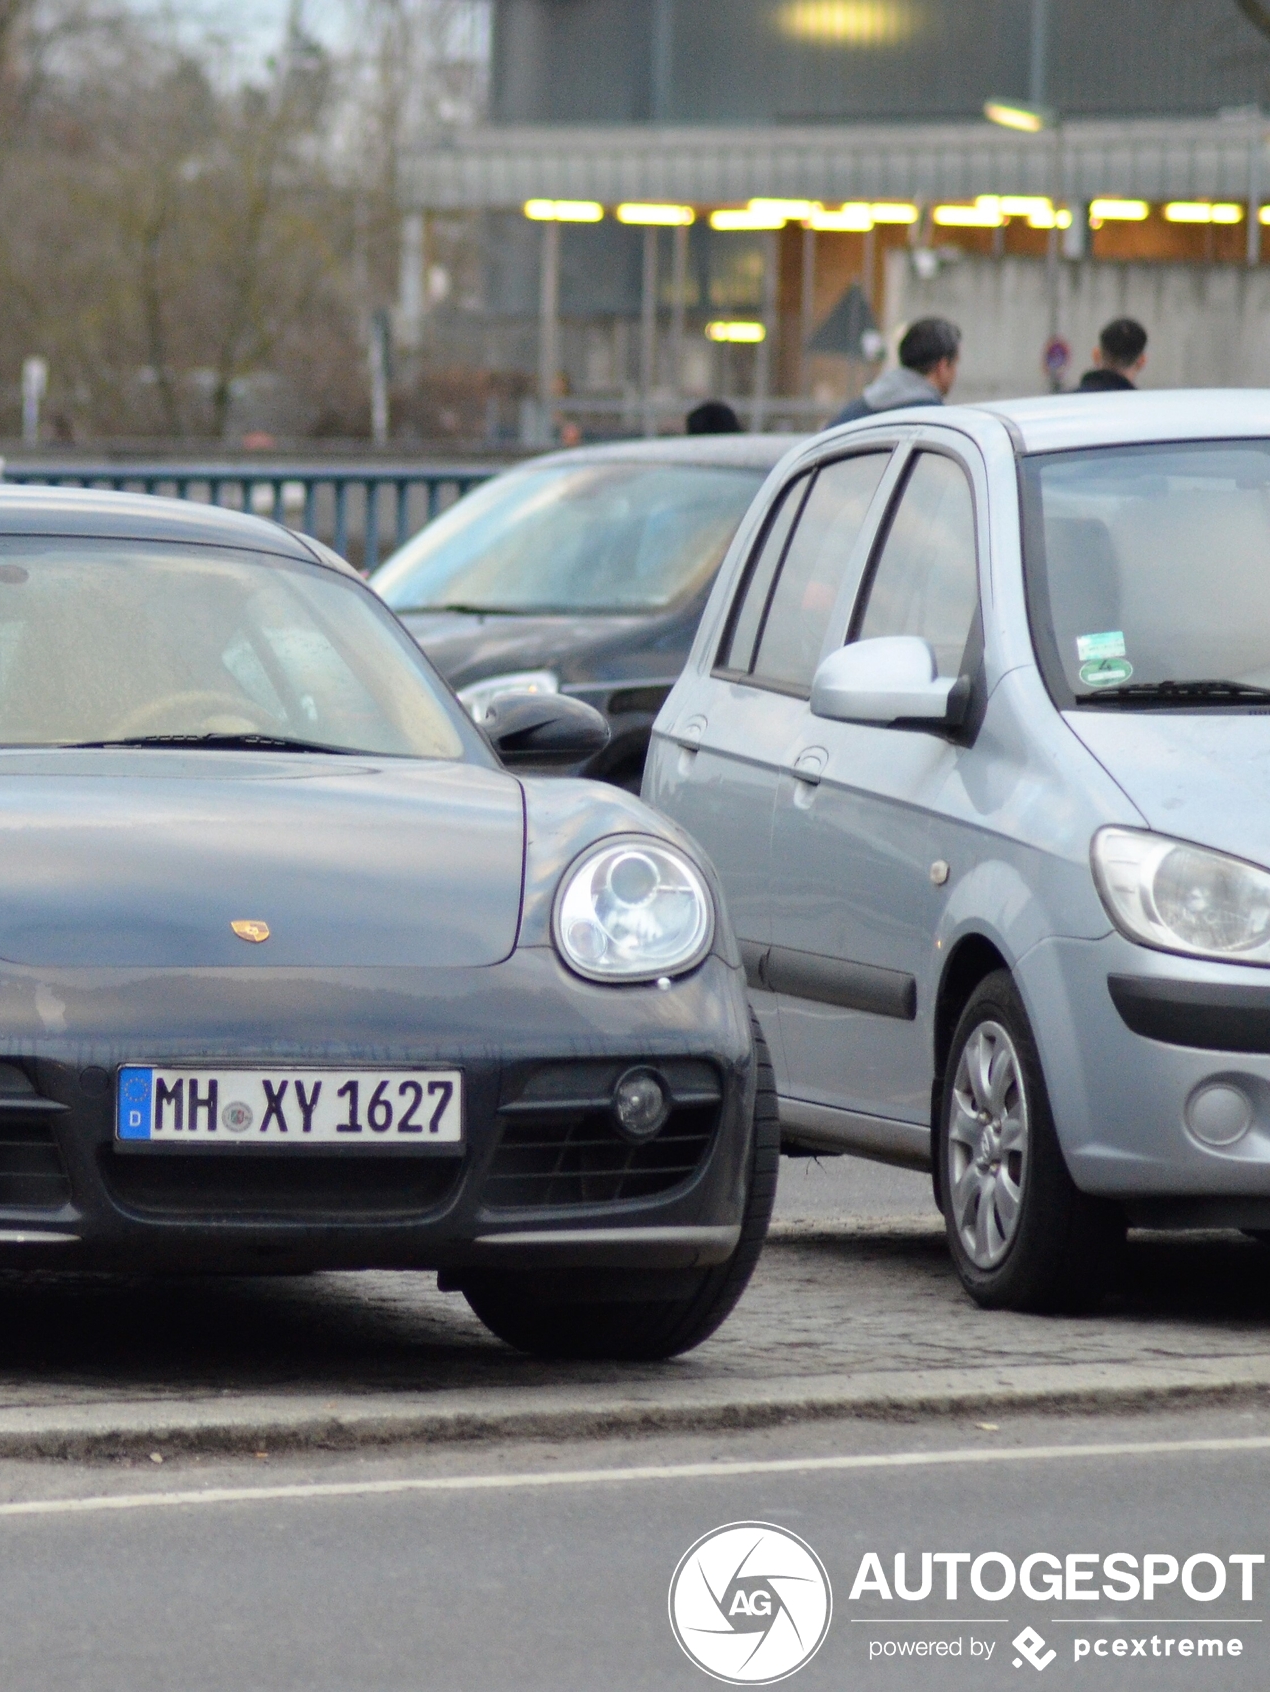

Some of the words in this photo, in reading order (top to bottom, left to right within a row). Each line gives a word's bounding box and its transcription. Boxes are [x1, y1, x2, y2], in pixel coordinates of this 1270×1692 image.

[129, 1110, 141, 1127] D
[154, 1077, 218, 1132] MH
[259, 1079, 322, 1133] XY
[336, 1080, 454, 1133] 1627
